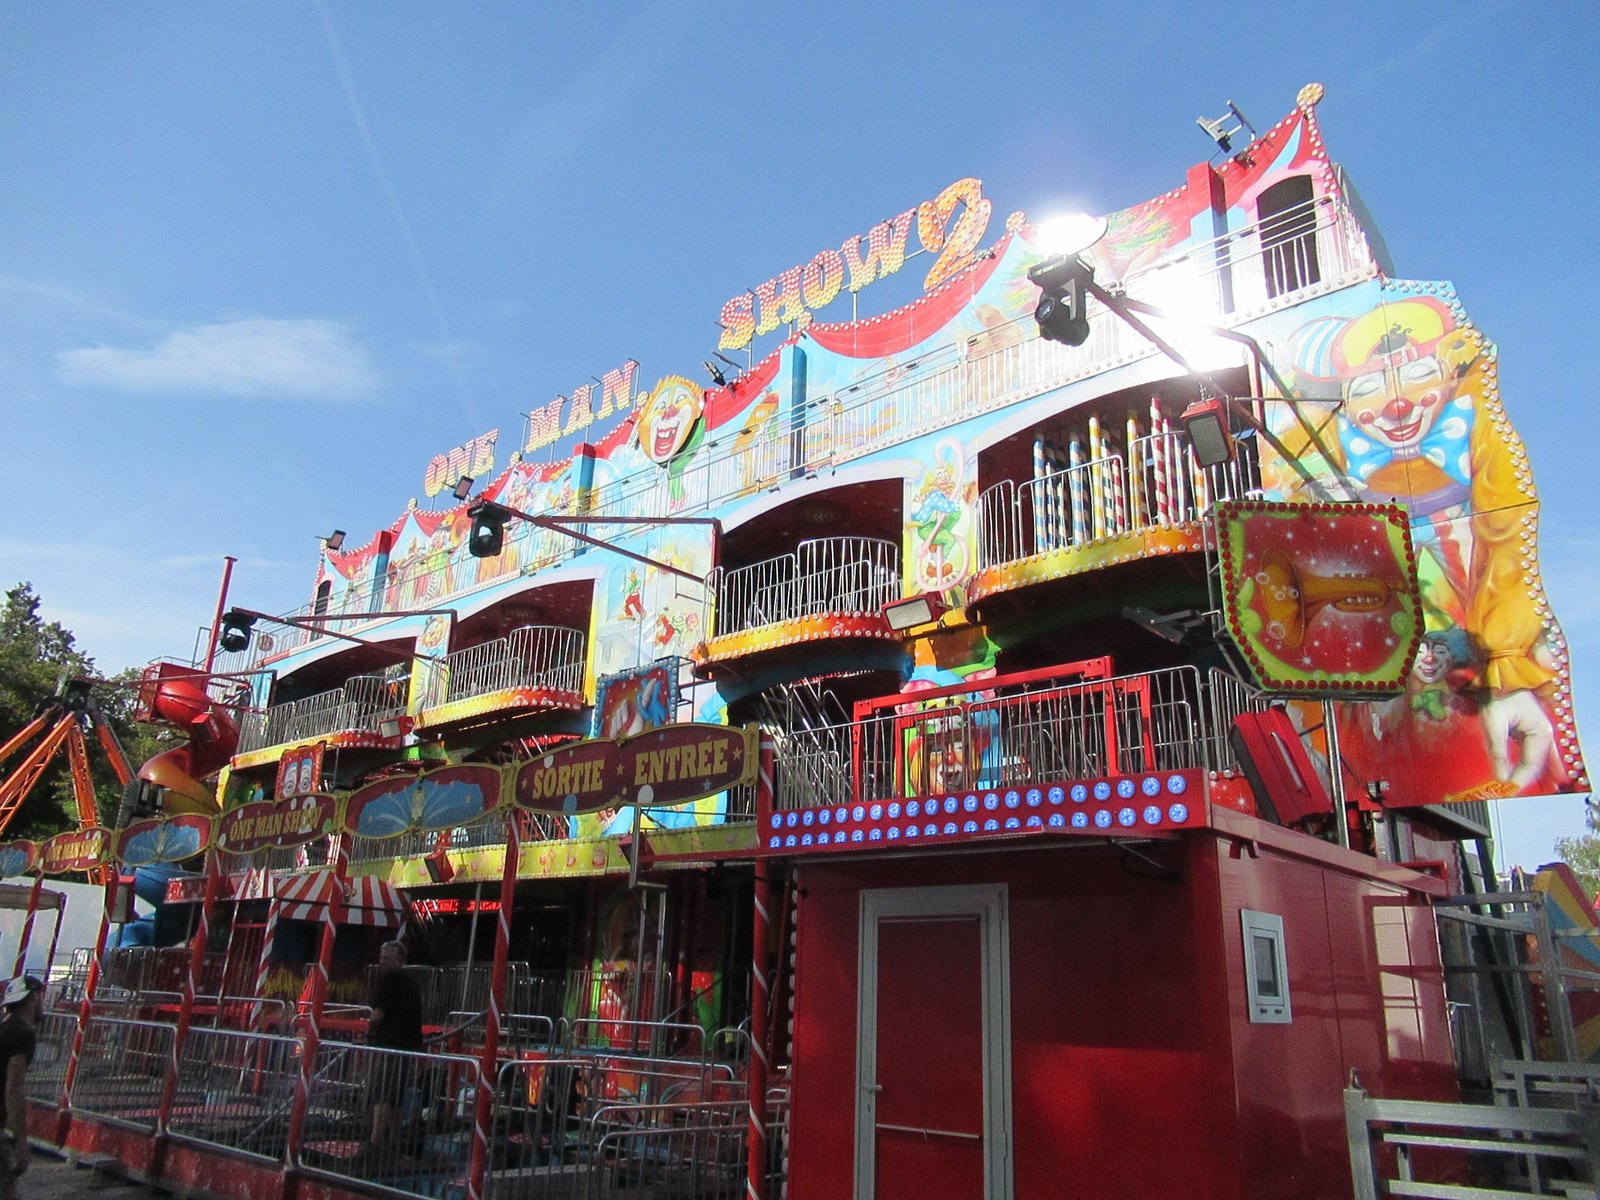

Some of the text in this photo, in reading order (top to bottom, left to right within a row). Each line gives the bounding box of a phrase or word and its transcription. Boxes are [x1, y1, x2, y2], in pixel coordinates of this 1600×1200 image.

[425, 178, 992, 498] ONE MAN SHOW 2
[532, 735, 728, 799] SORTIE ENTRÉE
[230, 818, 254, 842] ONE
[254, 812, 283, 838] MAN
[283, 806, 323, 834] SHOW
